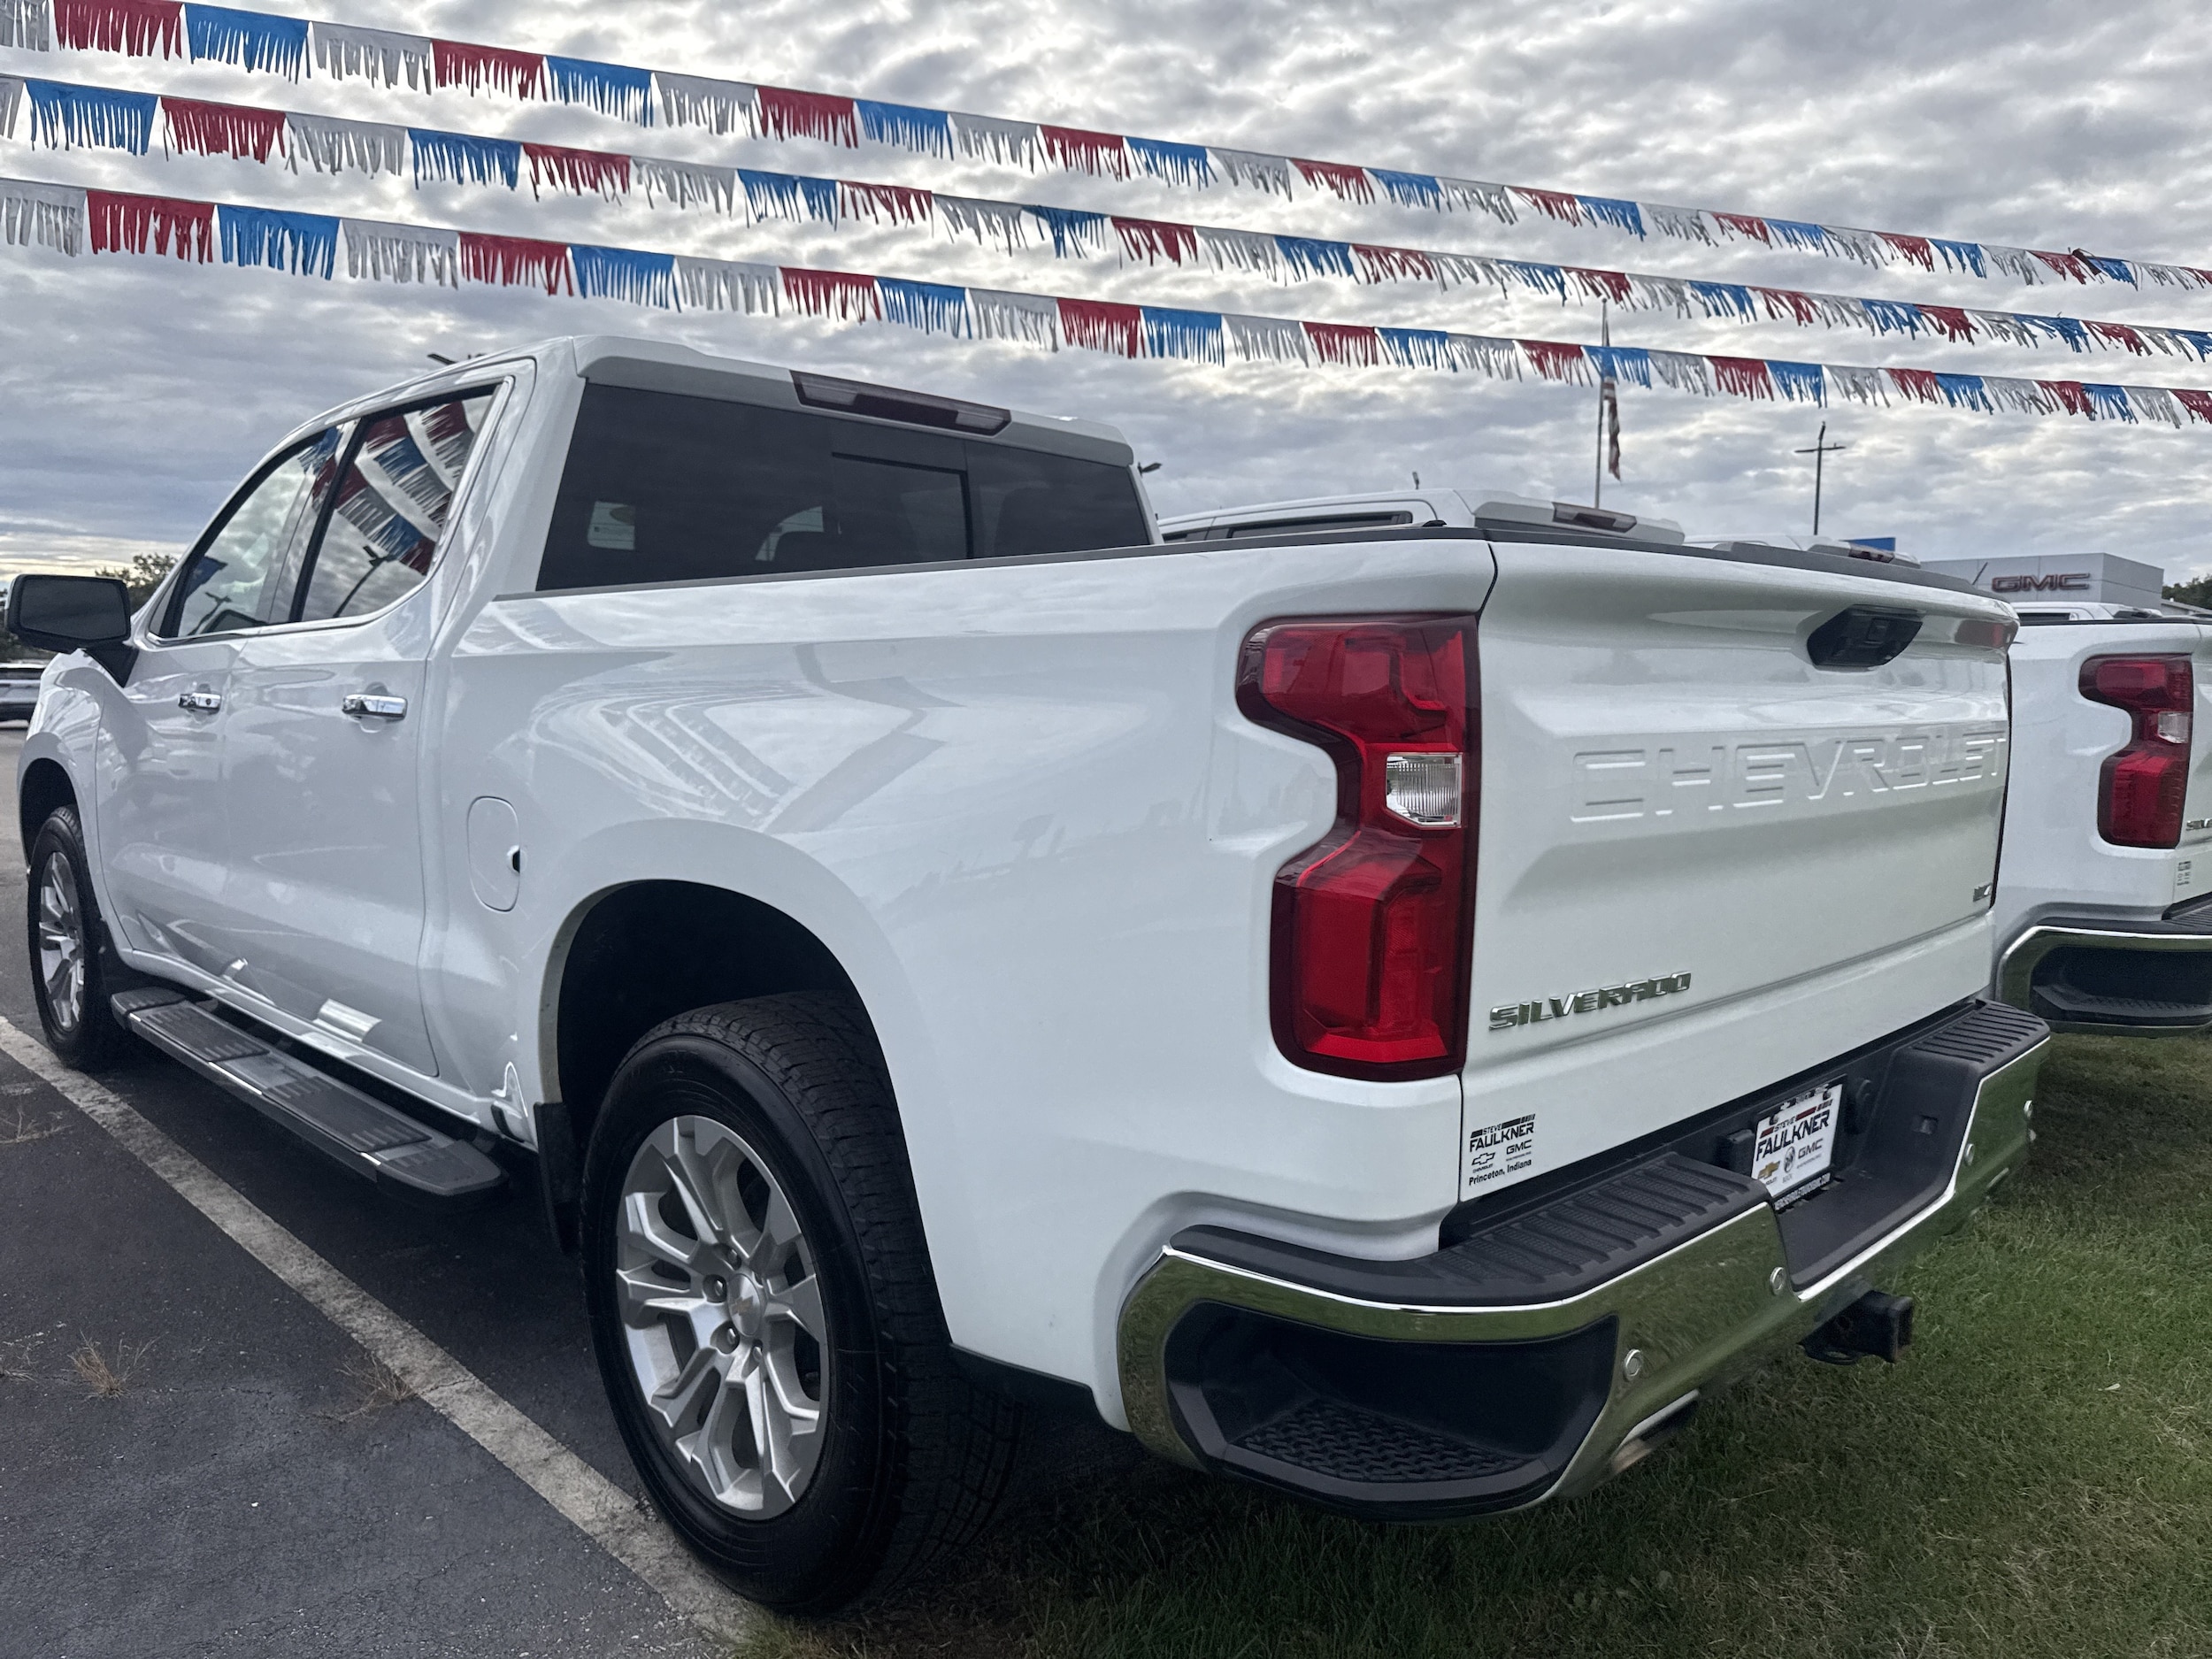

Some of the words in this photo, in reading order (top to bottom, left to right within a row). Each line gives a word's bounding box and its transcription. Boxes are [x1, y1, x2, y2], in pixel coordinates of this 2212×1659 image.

[1992, 572, 2091, 593] GMC
[1570, 730, 2007, 822] CHEVROLET
[1489, 971, 1692, 1031] SILVERADO
[1470, 1122, 1534, 1152] FAULKNER
[1482, 1123, 1503, 1136] STEVE
[1755, 1109, 1831, 1162] FAULKNER
[1506, 1139, 1532, 1155] GMC
[1798, 1138, 1824, 1160] GMC
[1469, 1168, 1506, 1187] Princeton,
[1507, 1159, 1532, 1173] Indiana
